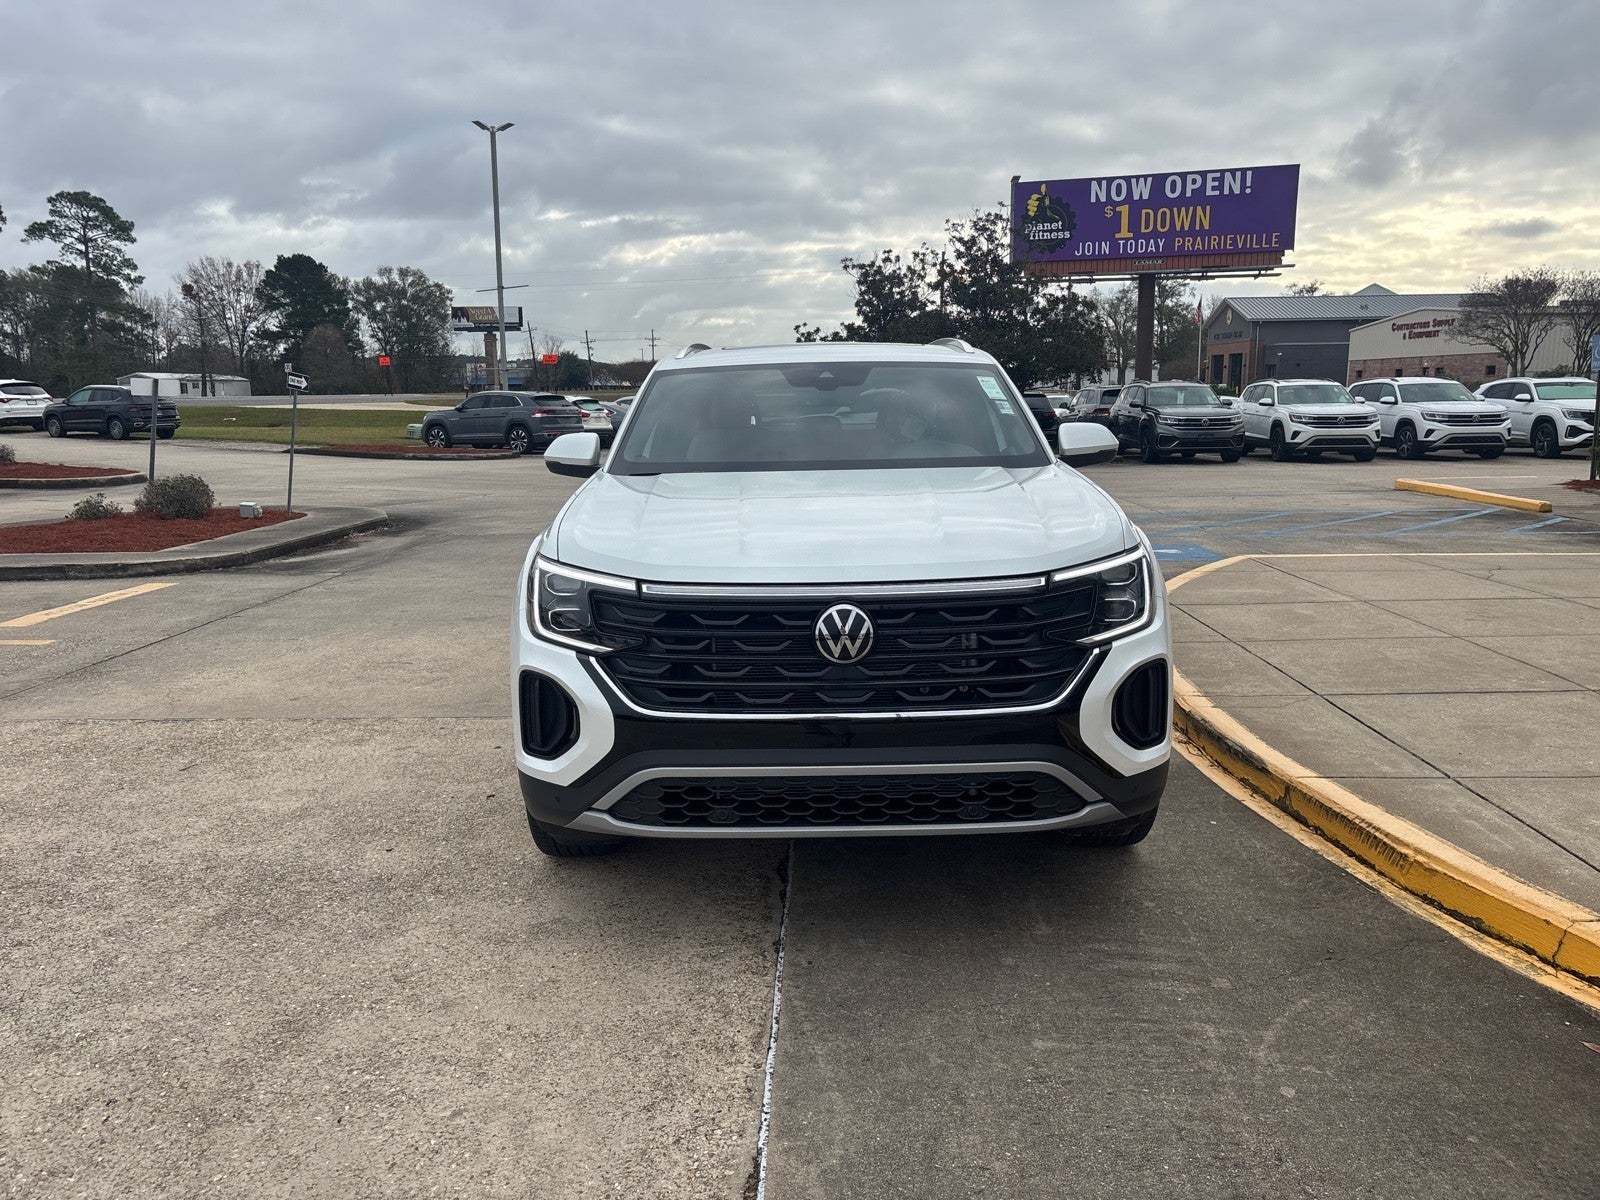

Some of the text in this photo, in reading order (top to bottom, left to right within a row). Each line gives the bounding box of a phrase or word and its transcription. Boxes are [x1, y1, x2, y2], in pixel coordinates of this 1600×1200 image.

[1090, 170, 1253, 203] NOW OPEN!
[1029, 230, 1070, 240] fitness
[1104, 204, 1211, 239] $1 DOWN
[1075, 232, 1280, 256] JOIN TODAY PRAIRIEVILLE
